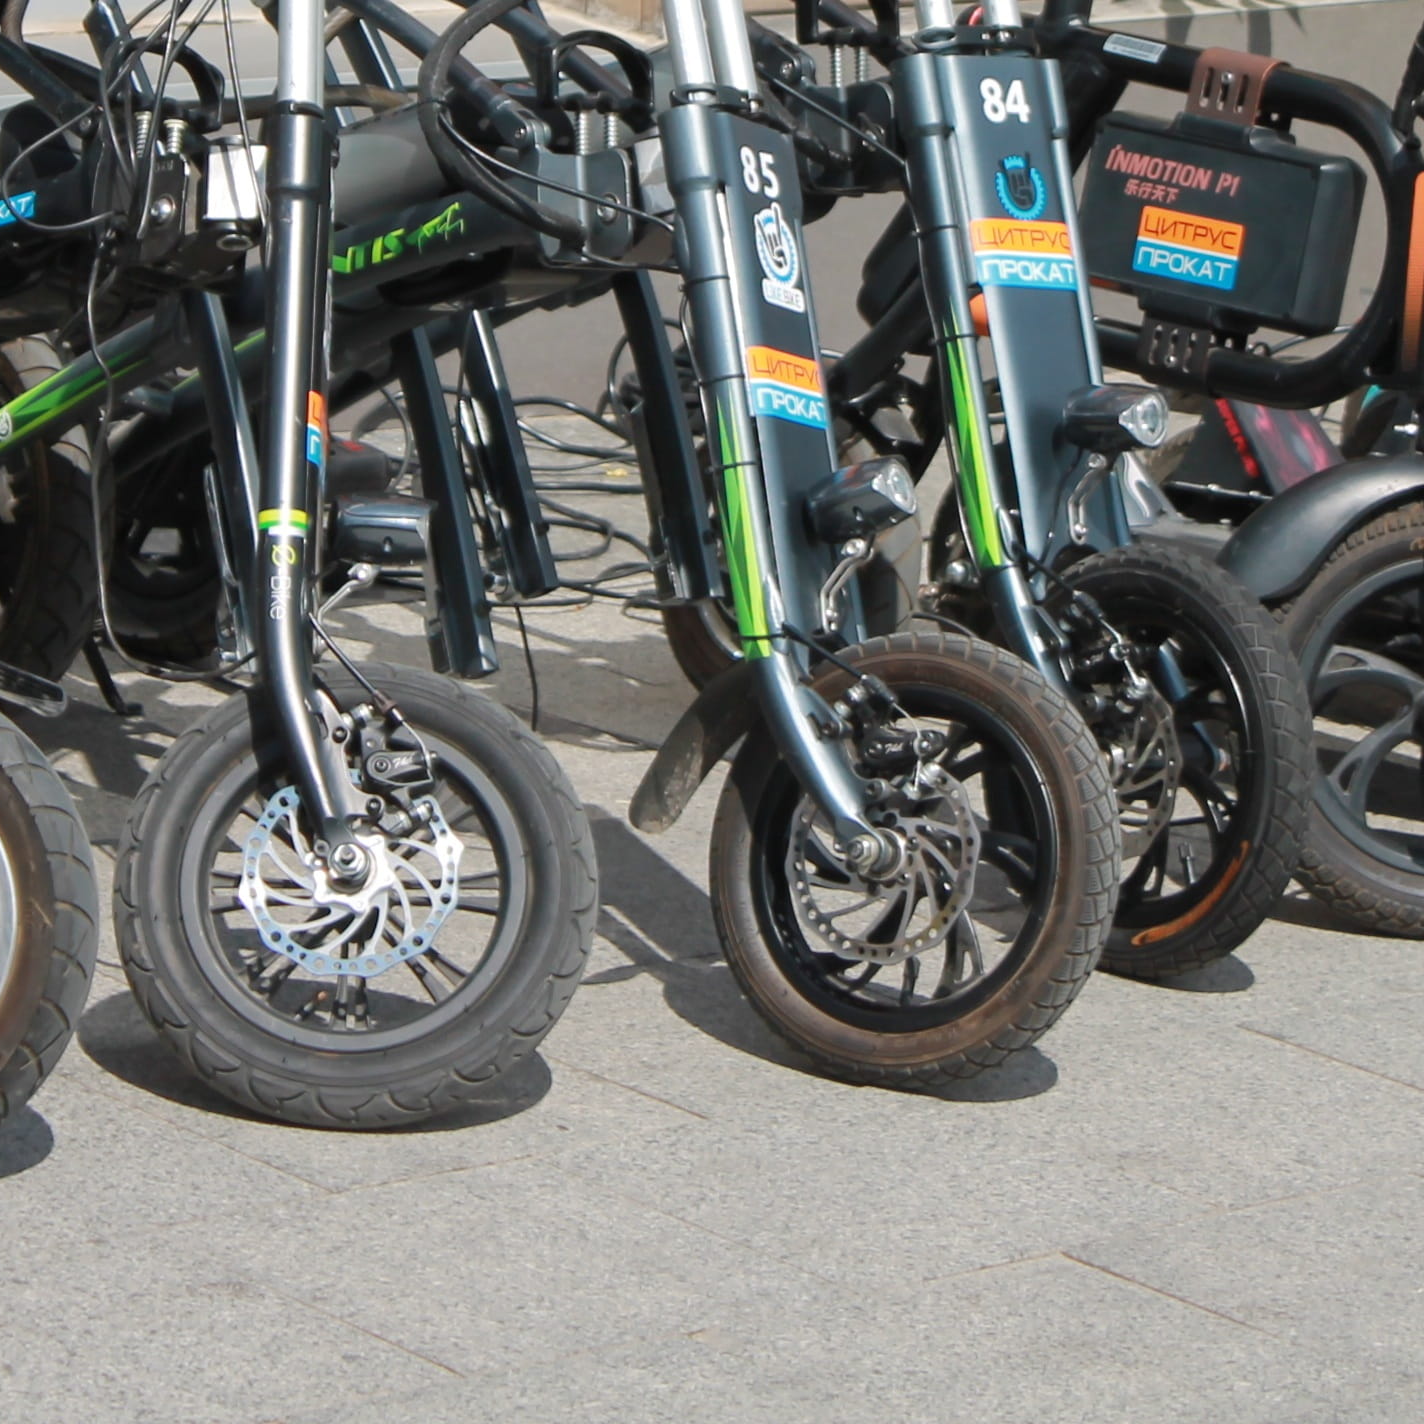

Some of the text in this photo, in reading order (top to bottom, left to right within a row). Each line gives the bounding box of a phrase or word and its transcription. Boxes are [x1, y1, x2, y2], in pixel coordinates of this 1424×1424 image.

[980, 77, 1030, 123] 84
[740, 146, 780, 198] 85
[1215, 172, 1241, 197] P1
[977, 226, 1071, 250] ЦИТРУС
[1144, 215, 1237, 251] ЦИТРУС
[981, 258, 1075, 284] ПРОКАТ
[1137, 247, 1232, 282] ПРОКАТ
